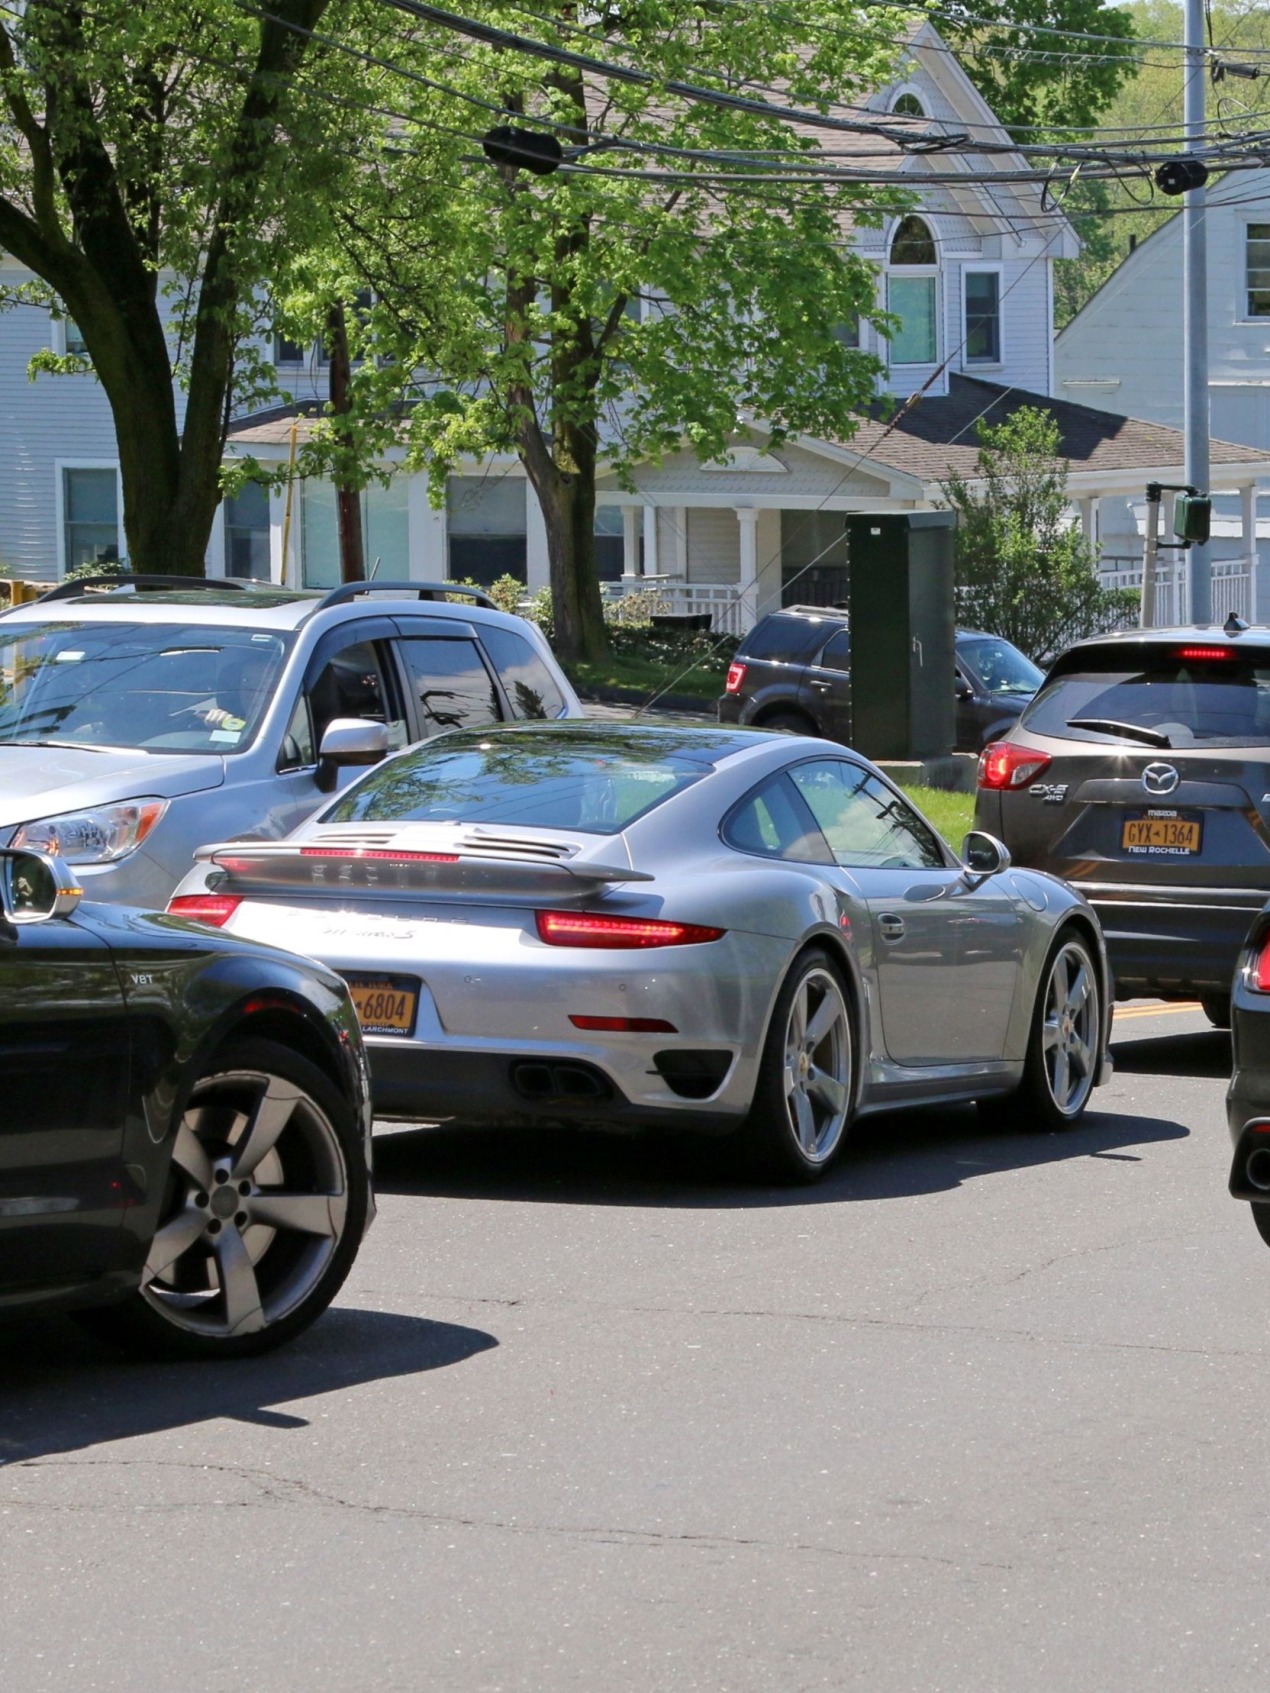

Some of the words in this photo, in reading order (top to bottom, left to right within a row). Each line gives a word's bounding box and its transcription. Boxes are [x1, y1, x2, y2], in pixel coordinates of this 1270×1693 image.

[1028, 784, 1069, 794] CX-5
[1148, 846, 1190, 855] ROCHELLE
[130, 974, 153, 984] V8T
[362, 1026, 408, 1034] LARCHMONT
